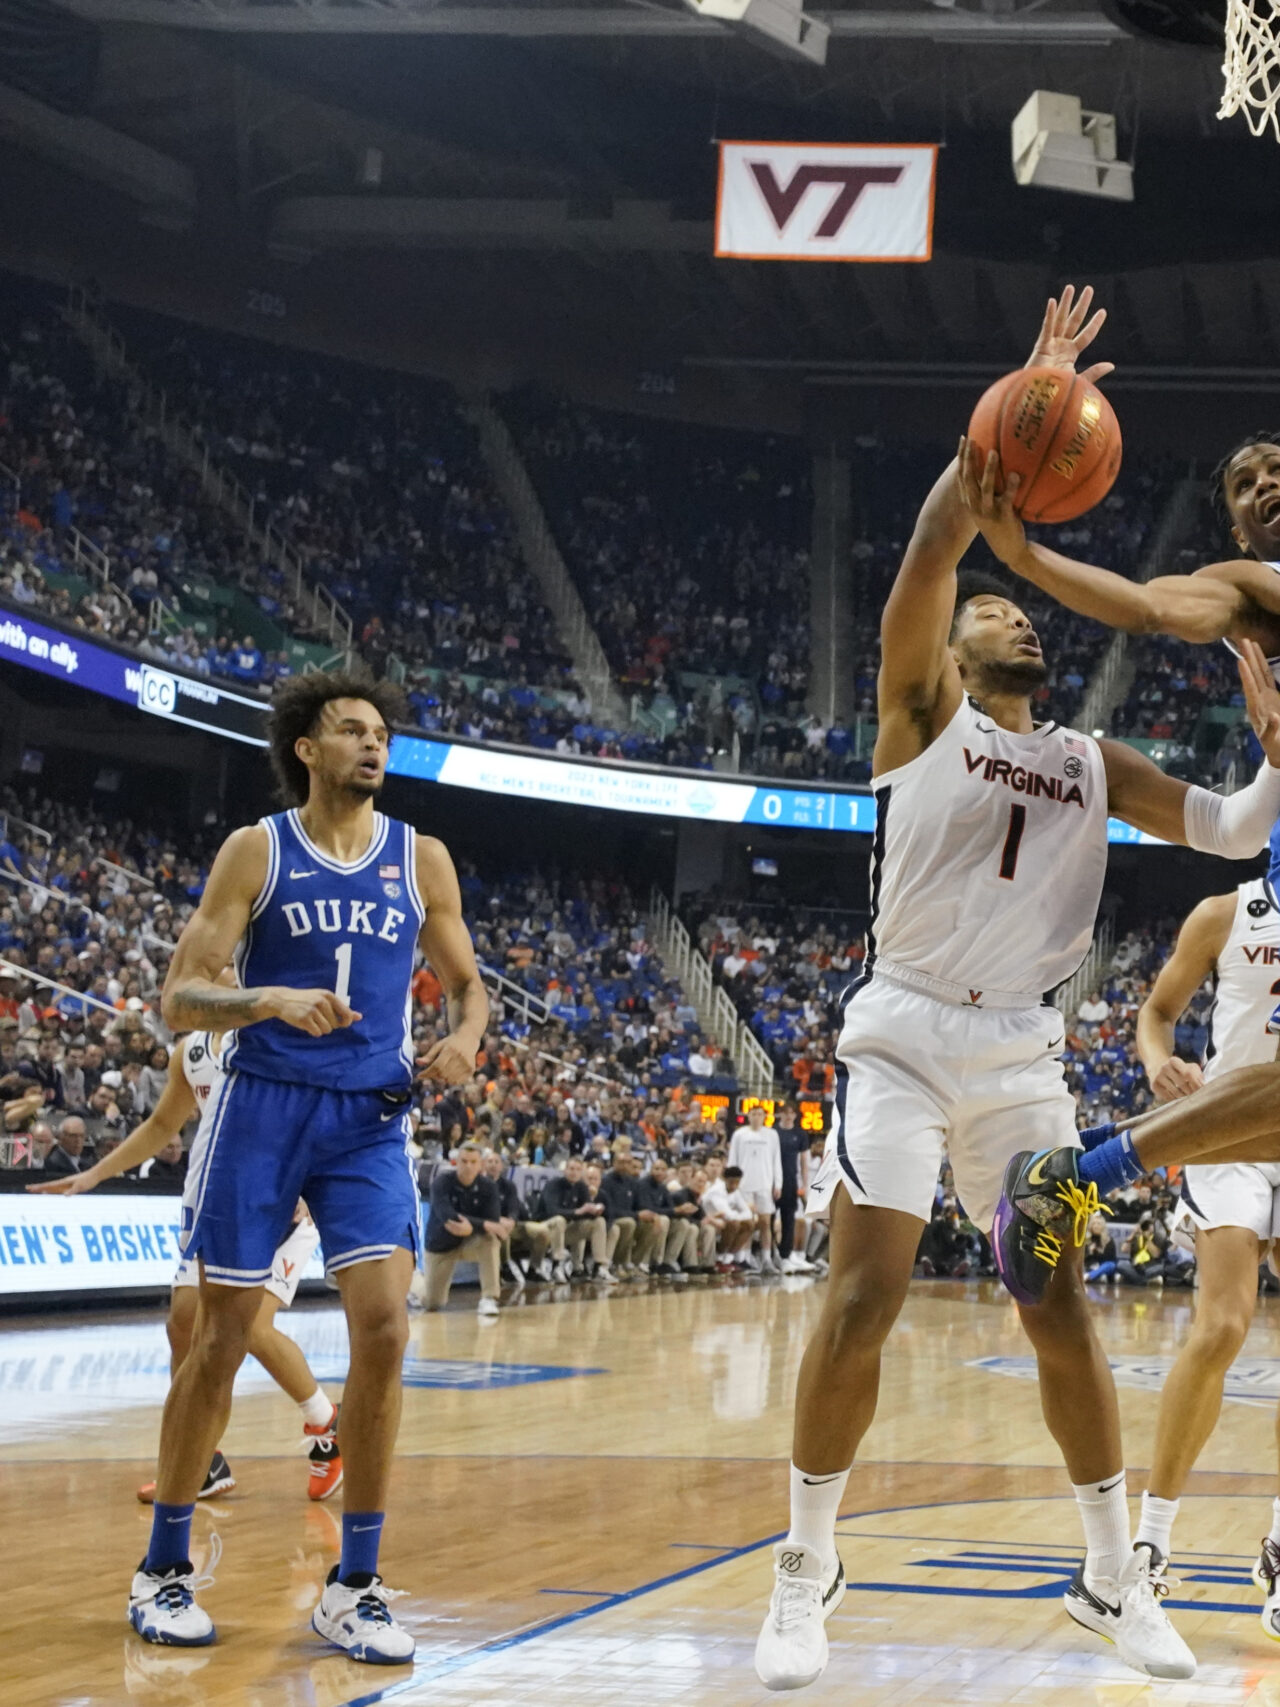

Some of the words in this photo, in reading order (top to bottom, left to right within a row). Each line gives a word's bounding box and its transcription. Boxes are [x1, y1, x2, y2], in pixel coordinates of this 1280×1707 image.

[743, 158, 911, 241] VT
[28, 635, 49, 660] an
[50, 641, 78, 674] ally.
[480, 772, 499, 785] ACC
[538, 781, 599, 799] BASKETBALL
[609, 791, 679, 807] TOURNAMENT
[598, 775, 618, 787] NEW
[625, 778, 651, 791] YORK
[655, 782, 679, 794] LIFE
[963, 747, 1085, 809] VIRGINIA
[763, 794, 782, 820] 0
[816, 797, 825, 811] 2
[817, 811, 823, 824] 1
[848, 801, 859, 826] 1
[998, 803, 1026, 881] 1
[1127, 829, 1138, 840] 2
[281, 899, 406, 944] DUKE
[335, 943, 353, 1009] 1
[800, 1111, 824, 1131] 26
